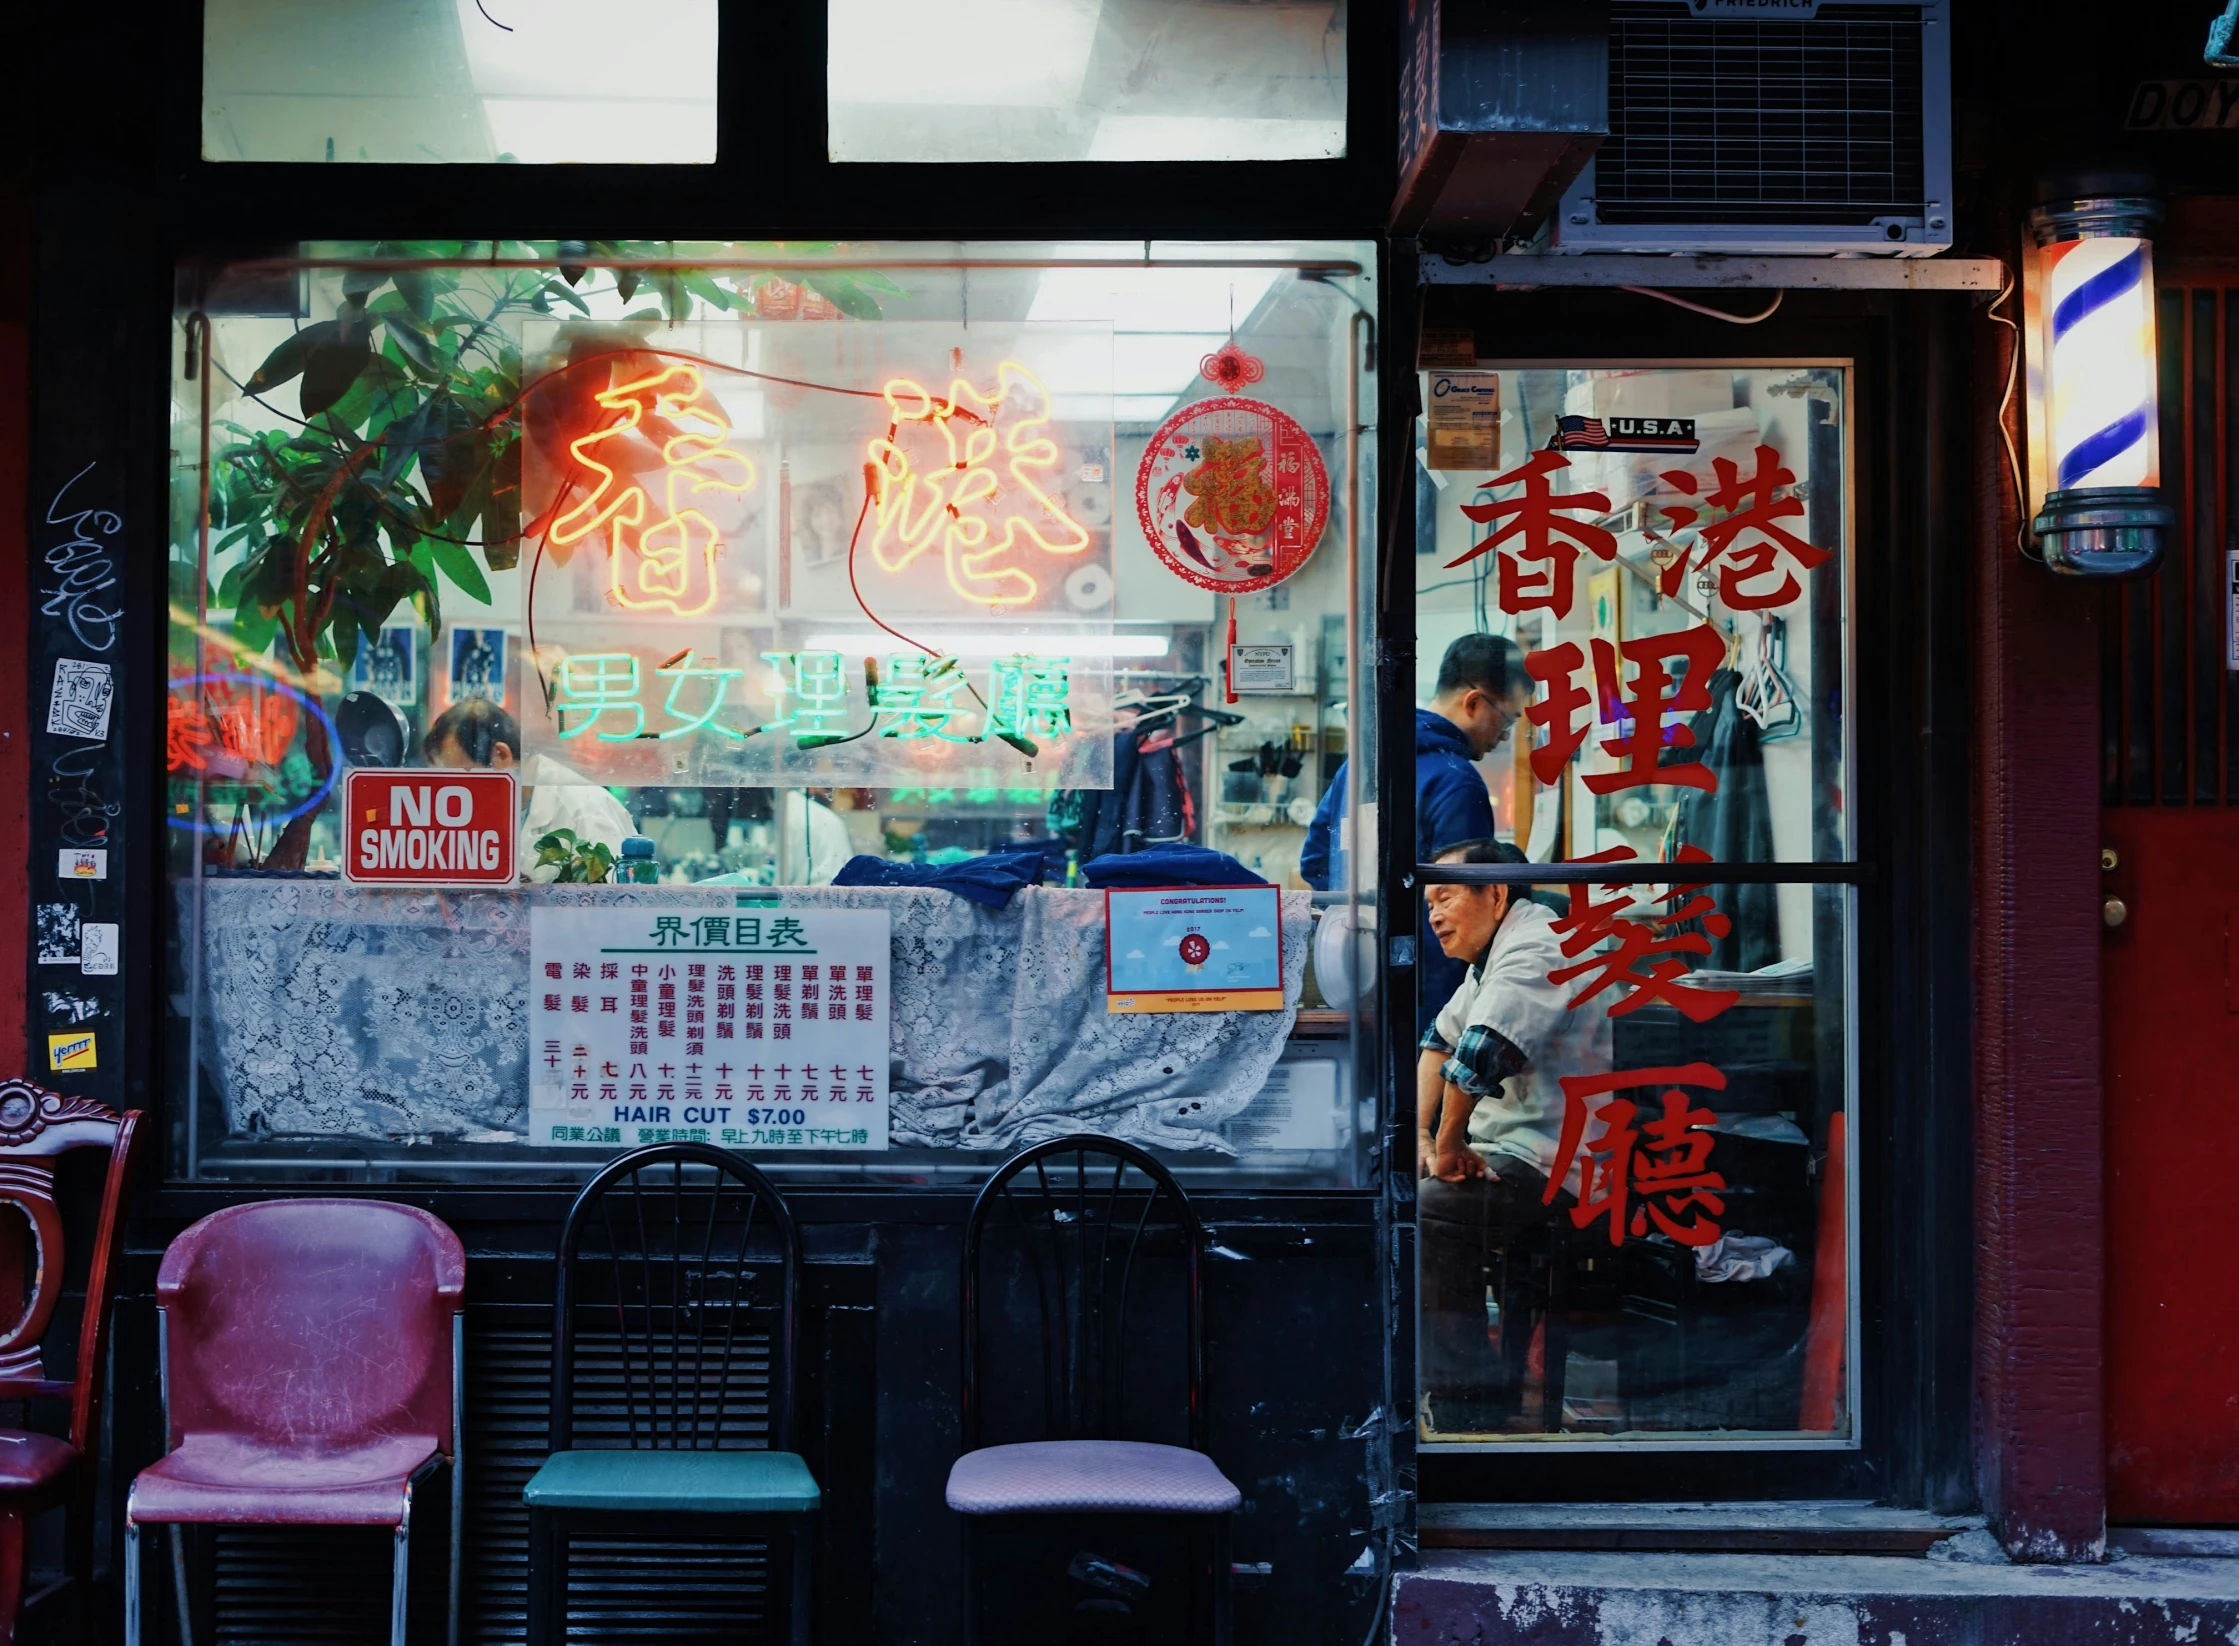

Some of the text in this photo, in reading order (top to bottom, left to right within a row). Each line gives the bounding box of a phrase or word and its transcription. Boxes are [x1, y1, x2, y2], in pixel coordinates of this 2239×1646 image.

[1443, 444, 1834, 621] 香港
[556, 649, 1076, 746] 男女理髮廳
[390, 786, 474, 827] NO
[360, 829, 500, 870] SMOKING
[1160, 897, 1227, 905] CONGRATULATIONS!
[649, 916, 808, 947] 界價目表
[658, 964, 676, 1037] 小童理髮
[773, 965, 792, 1101] 理髮洗頭 十元
[629, 1063, 647, 1100] 八元
[715, 1063, 733, 1100] 十元
[747, 1064, 765, 1101] 十元
[801, 1064, 819, 1101] 七元
[829, 1064, 847, 1102] 七元
[856, 1065, 874, 1102] 七元
[614, 1106, 806, 1126] HAIR CUT $7.00
